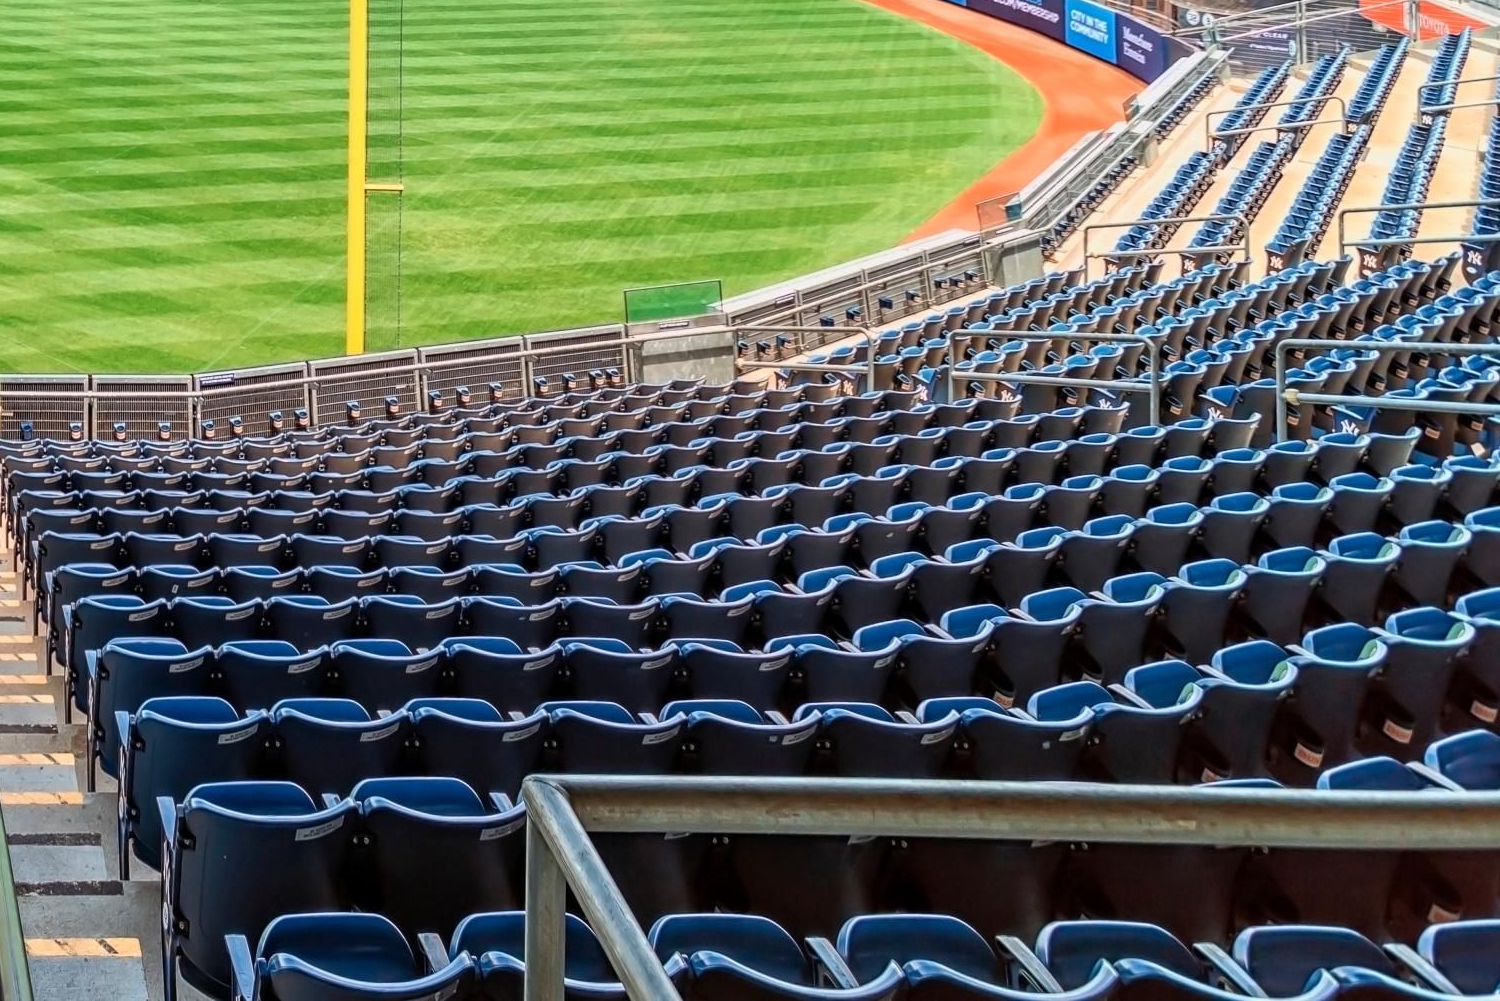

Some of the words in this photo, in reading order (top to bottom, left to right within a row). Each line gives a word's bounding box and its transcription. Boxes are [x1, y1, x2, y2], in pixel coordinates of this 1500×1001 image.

[1069, 19, 1110, 45] COMMUNITY
[1070, 9, 1085, 23] CITY
[1085, 13, 1094, 26] IN
[1094, 16, 1108, 33] THE
[1419, 13, 1450, 35] TOYOTA
[1262, 32, 1289, 40] CLEAR
[1467, 250, 1483, 267] NY
